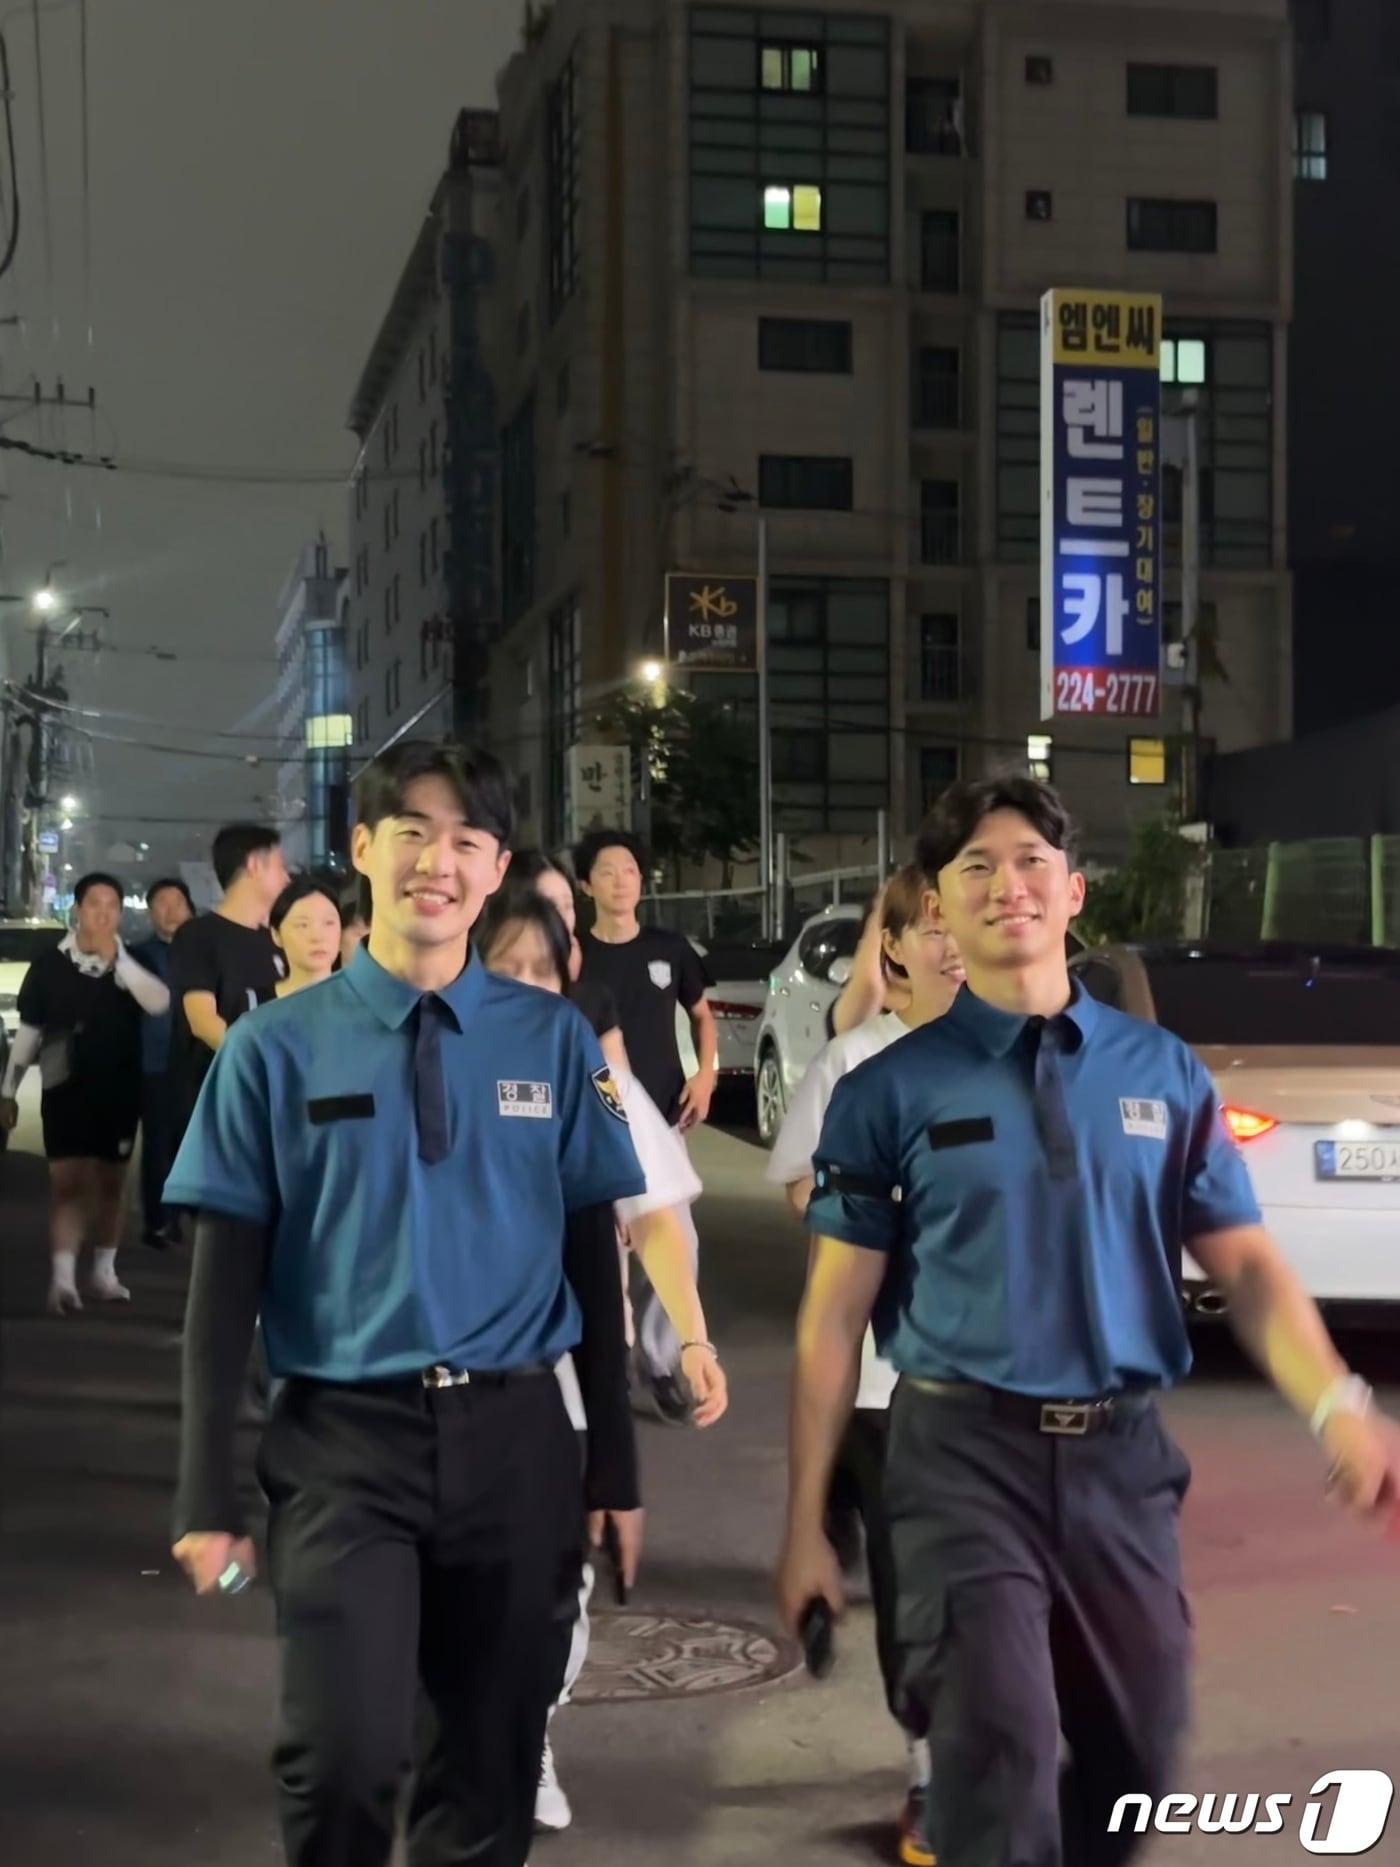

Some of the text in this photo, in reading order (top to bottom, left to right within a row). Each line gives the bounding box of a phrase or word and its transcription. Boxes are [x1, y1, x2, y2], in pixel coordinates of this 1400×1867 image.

[1059, 302, 1154, 355] 엠엔씨
[1060, 380, 1130, 655] 렌트카
[1057, 672, 1156, 712] 224-2777
